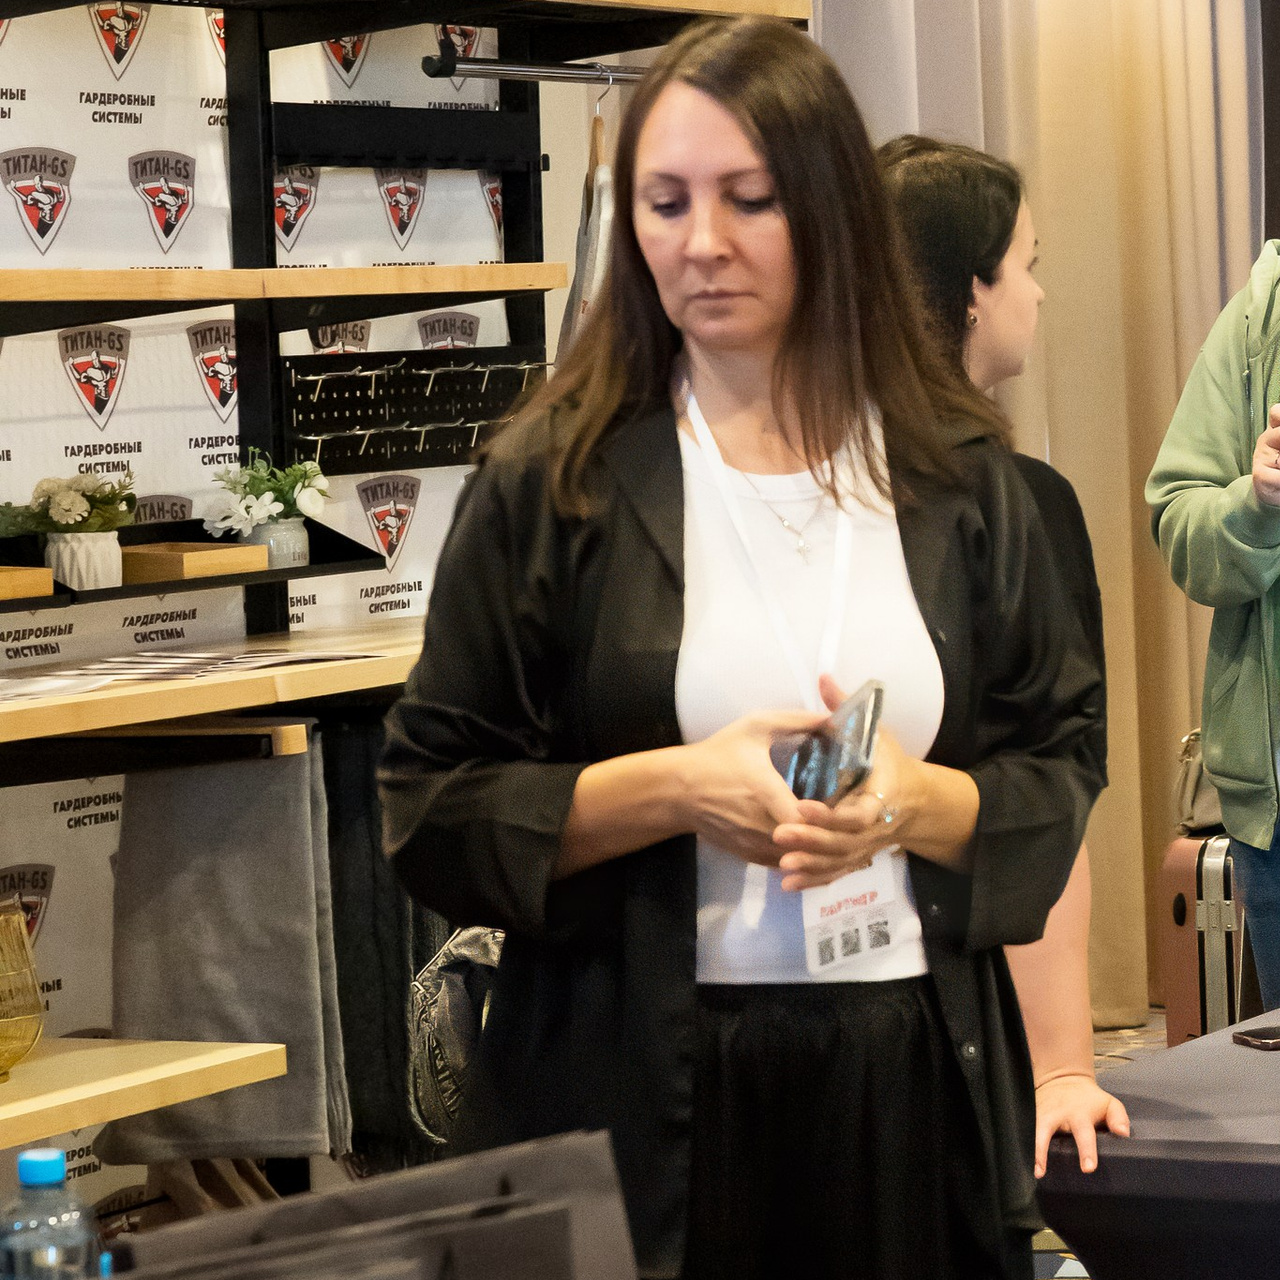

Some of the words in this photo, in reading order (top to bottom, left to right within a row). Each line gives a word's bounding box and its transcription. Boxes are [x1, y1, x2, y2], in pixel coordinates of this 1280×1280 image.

[79, 91, 156, 106] ГАРДЕРОБНЫЕ
[91, 110, 143, 125] СИСТЕМЫ
[3, 154, 68, 178] ТИТАН-GS
[133, 156, 190, 180] ТИТАН-GS
[422, 319, 475, 339] ТИТАН-GS
[62, 330, 125, 354] ТИТАН-GS
[64, 441, 142, 458] ГАРДЕРОБНЫЕ
[78, 460, 130, 475] СИСТЕМЫ
[361, 480, 416, 503] ТИТАН-GS
[359, 580, 423, 600] ГАРДЕРОБНЫЕ
[368, 598, 411, 615] СИСТЕМЫ
[121, 607, 198, 628] ГАРДЕРОБНЫЕ
[0, 623, 74, 643] АРДЕРОБНЫЕ
[134, 627, 186, 644] СИСТЕМЫ
[5, 642, 61, 660] СИСТЕМЫ
[67, 809, 120, 830] СИСТЕМЫ
